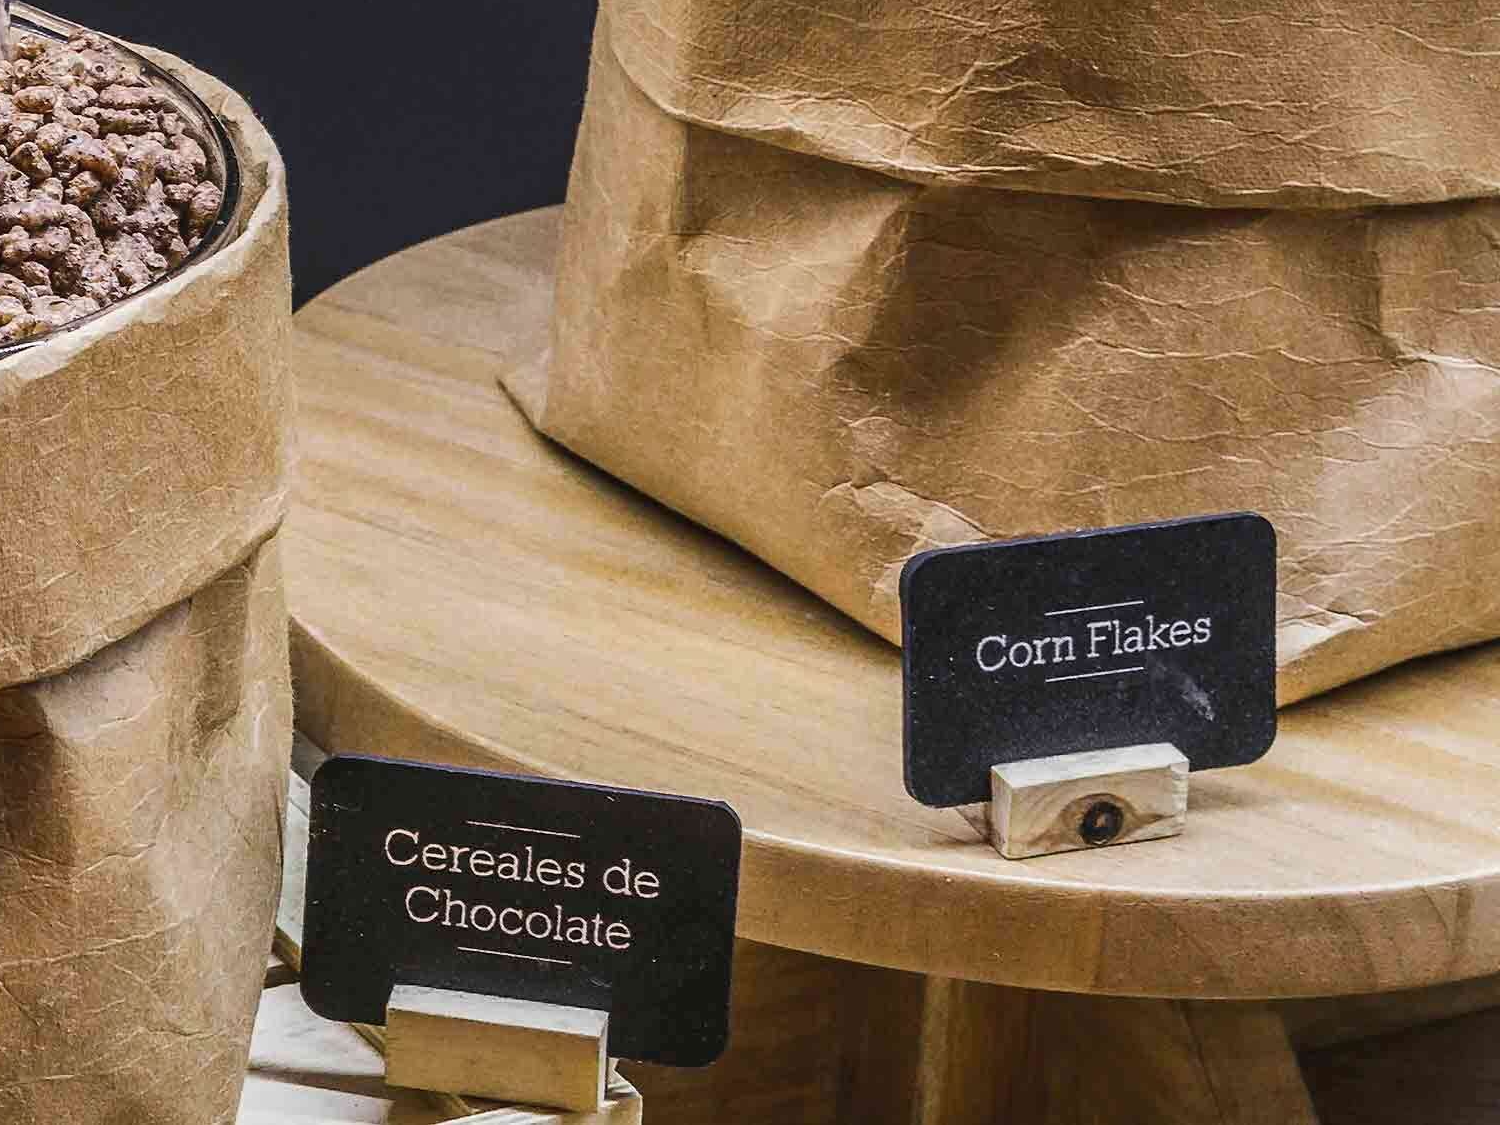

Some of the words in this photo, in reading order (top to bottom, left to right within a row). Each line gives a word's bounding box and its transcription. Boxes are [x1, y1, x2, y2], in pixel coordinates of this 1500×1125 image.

[976, 634, 1077, 672] Corn
[1086, 615, 1212, 658] Flakes
[384, 828, 586, 889] Cereales
[602, 858, 661, 899] de
[404, 886, 632, 950] Chocolate
